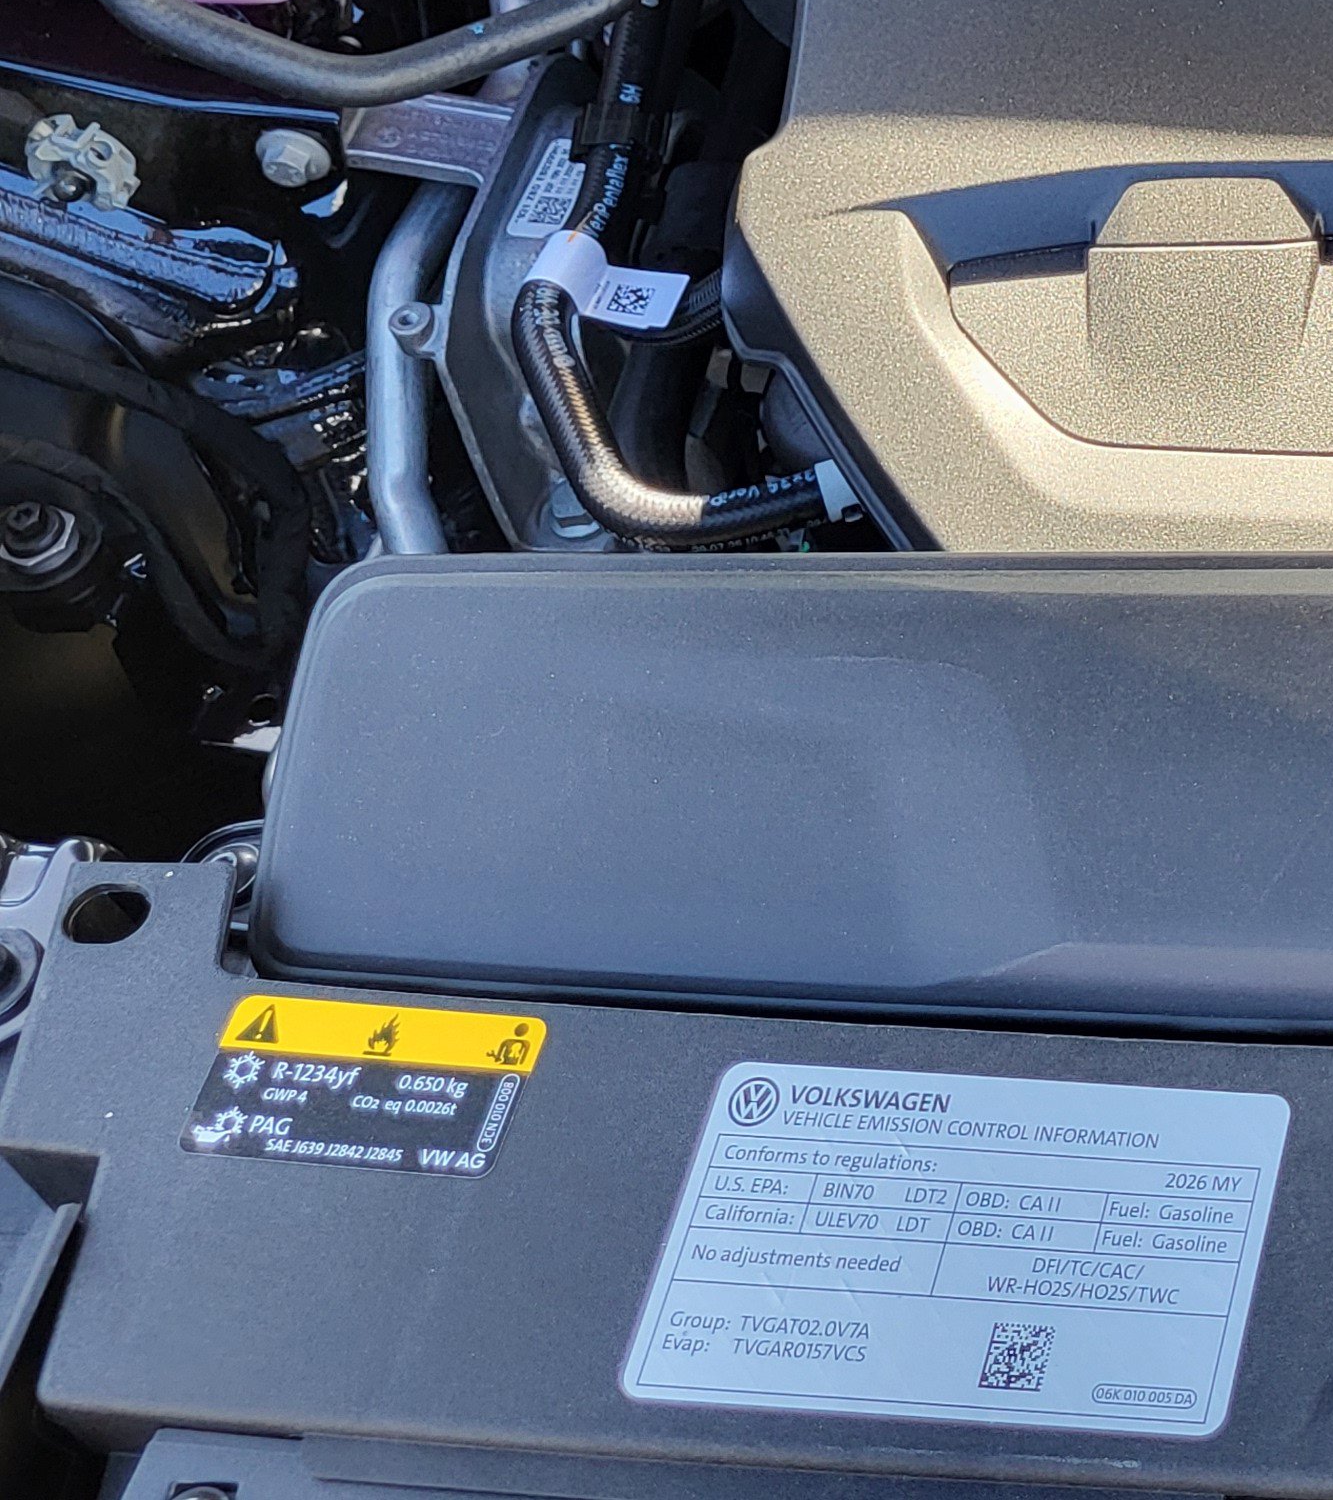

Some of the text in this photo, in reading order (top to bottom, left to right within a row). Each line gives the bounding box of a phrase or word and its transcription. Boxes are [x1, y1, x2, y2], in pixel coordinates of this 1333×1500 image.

[271, 1061, 362, 1090] R-1234yf
[398, 1074, 469, 1099] 0.650 kg
[262, 1087, 298, 1102] GWP
[791, 1084, 952, 1114] VOLKSWAGEN
[384, 1100, 403, 1115] eq
[404, 1099, 458, 1116] 0.0026t
[481, 1082, 515, 1144] 3CN 010 008
[248, 1115, 293, 1136] PAG
[783, 1110, 1160, 1149] VEHICLE EMISSION CONTROL INFORMATION
[264, 1138, 404, 1162] SAE J639 J2842 J2845
[422, 1148, 486, 1169] VW AG
[724, 1144, 938, 1173] Conforms to regulations:
[714, 1175, 789, 1196] U.S. EPA:
[822, 1182, 948, 1205] BIN70 LDT2
[1164, 1172, 1243, 1193] 2026 MY
[965, 1191, 1043, 1212] OBD: CA
[1108, 1200, 1234, 1224] Fuel: Gasoline
[705, 1203, 795, 1226] California:
[815, 1210, 932, 1234] ULEV70 LDT
[957, 1220, 1035, 1241] OBD: CA
[1101, 1230, 1228, 1254] Fuel: Gasoline
[691, 1244, 903, 1273] No adjustments needed
[1031, 1257, 1146, 1279] DFI/TC/CAC/
[670, 1310, 731, 1334] Group:
[661, 1332, 710, 1357] Evap:
[1095, 1386, 1193, 1406] 06K 010 005 DA
